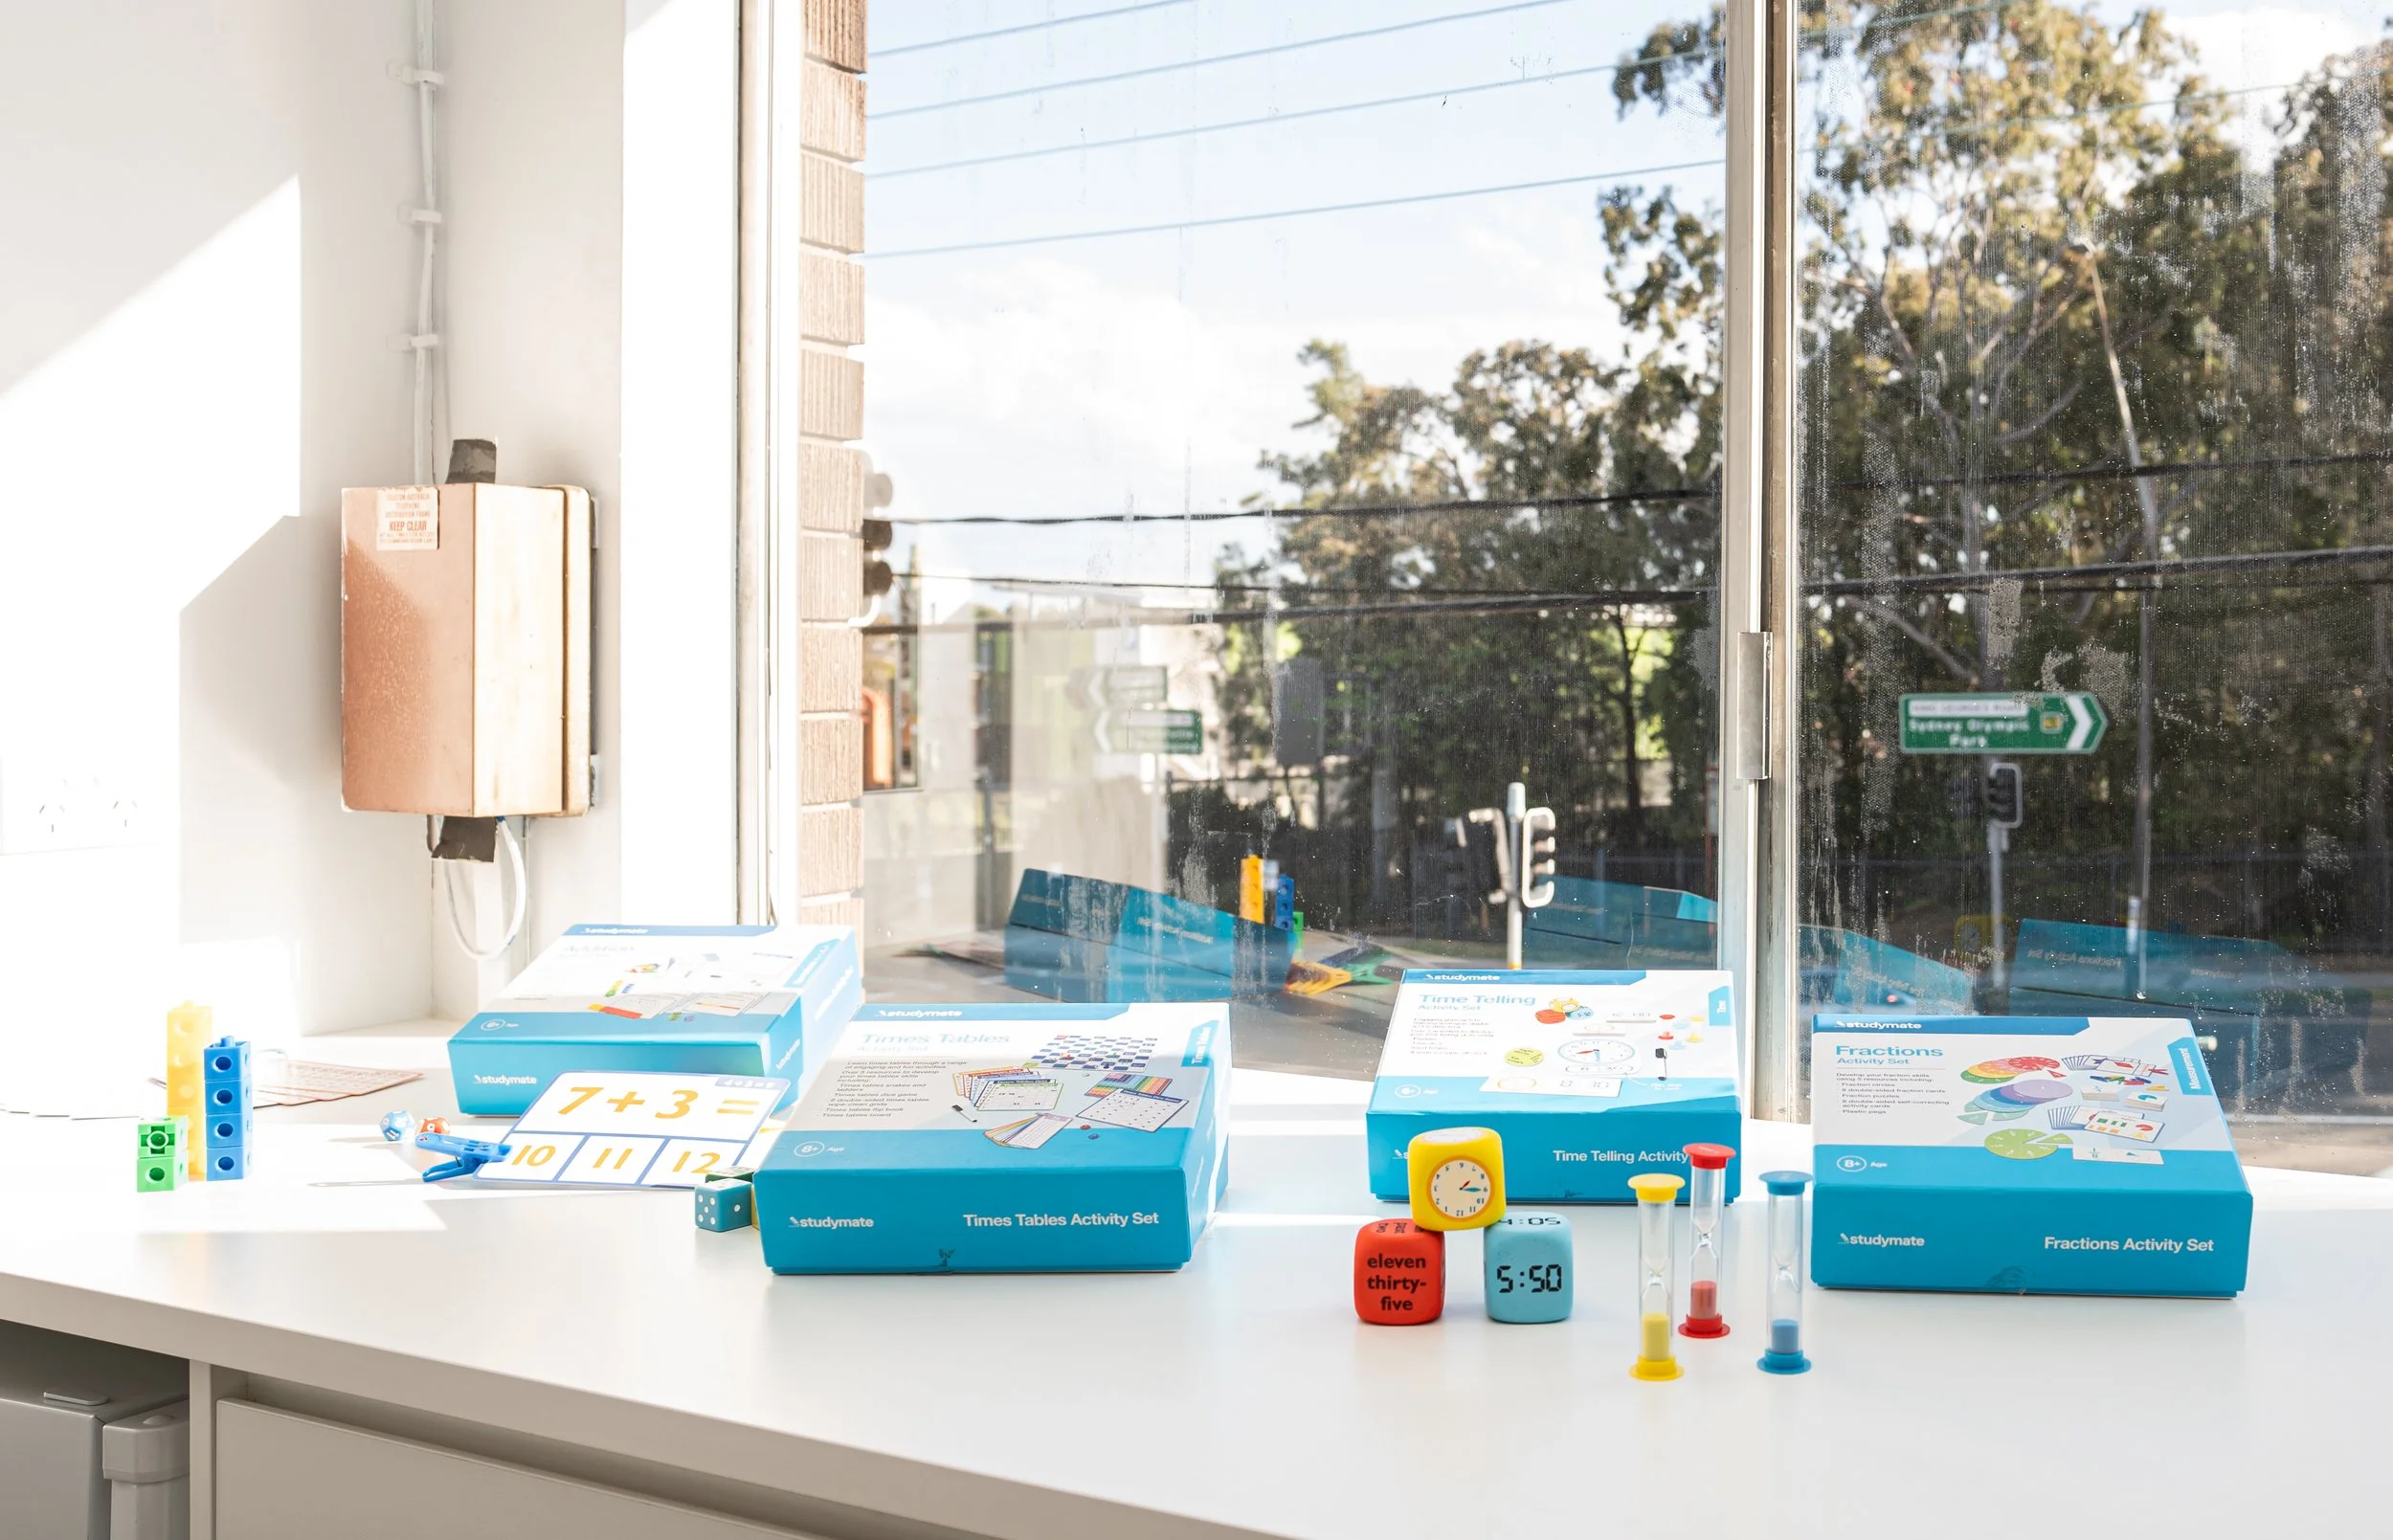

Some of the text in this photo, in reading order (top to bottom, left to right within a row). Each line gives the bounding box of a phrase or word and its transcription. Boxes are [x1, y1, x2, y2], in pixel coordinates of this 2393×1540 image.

[389, 521, 427, 531] KEEP CLEAR
[1434, 973, 1501, 982] studymate
[1419, 994, 1537, 1007] Time Telling
[886, 1010, 963, 1018] studymate
[862, 1033, 1011, 1044] Times Tables
[1836, 1045, 1944, 1057] Fractions
[2179, 1047, 2203, 1091] Measurement
[481, 1074, 538, 1086] studymate
[558, 1087, 603, 1116] 7
[656, 1089, 699, 1120] 3
[511, 1145, 555, 1168] 10
[593, 1148, 628, 1170] 11
[672, 1151, 722, 1175] 12
[1553, 1149, 1588, 1163] Time
[1590, 1149, 1635, 1165] Telling
[1638, 1149, 1689, 1165] Activity
[1844, 1159, 1861, 1168] 8+
[800, 1216, 874, 1230] studymate
[963, 1212, 1159, 1228] Times Tables Activity Set
[1849, 1234, 1925, 1248] studymate
[2044, 1237, 2214, 1254] Fractions Activity Set
[1367, 1254, 1426, 1268] eleven
[1367, 1275, 1426, 1294] thirty-
[1496, 1263, 1562, 1293] 5:50
[1380, 1296, 1413, 1311] five
